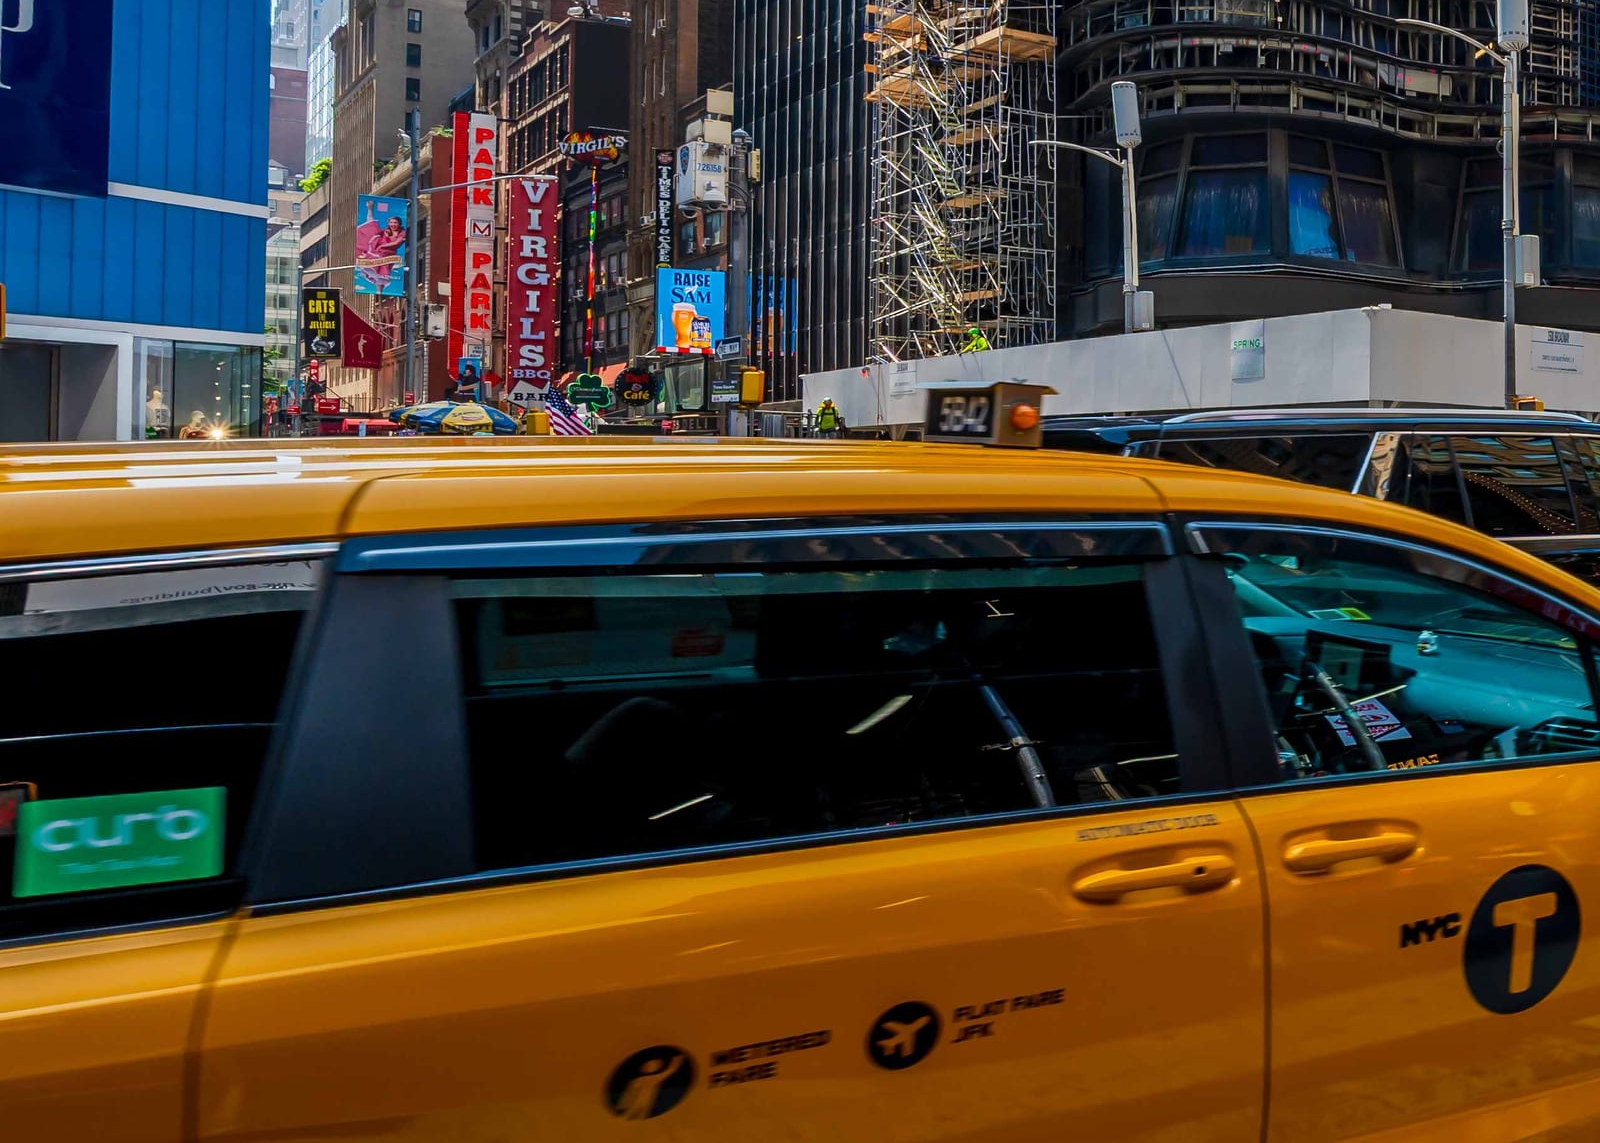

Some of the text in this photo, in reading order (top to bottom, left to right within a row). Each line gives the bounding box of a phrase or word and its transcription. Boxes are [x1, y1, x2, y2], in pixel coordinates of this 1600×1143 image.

[559, 135, 626, 155] VIRGIL'S
[471, 127, 495, 206] PARK
[657, 165, 672, 198] TIMES
[657, 200, 672, 227] DELI
[516, 180, 551, 368] VIRGILS
[674, 272, 711, 287] RAISE
[470, 252, 491, 330] PARK
[671, 288, 711, 304] SAM
[308, 299, 336, 314] CATS
[1233, 339, 1260, 350] SPRING
[513, 369, 550, 380] BBQ
[513, 393, 551, 402] BAR
[623, 390, 650, 399] Café
[32, 805, 209, 854] curb
[1399, 912, 1462, 949] NYC
[952, 988, 1066, 1023] FLAT FARE
[950, 1021, 996, 1045] JFK
[709, 1029, 833, 1068] METERED
[707, 1061, 779, 1090] FARE
